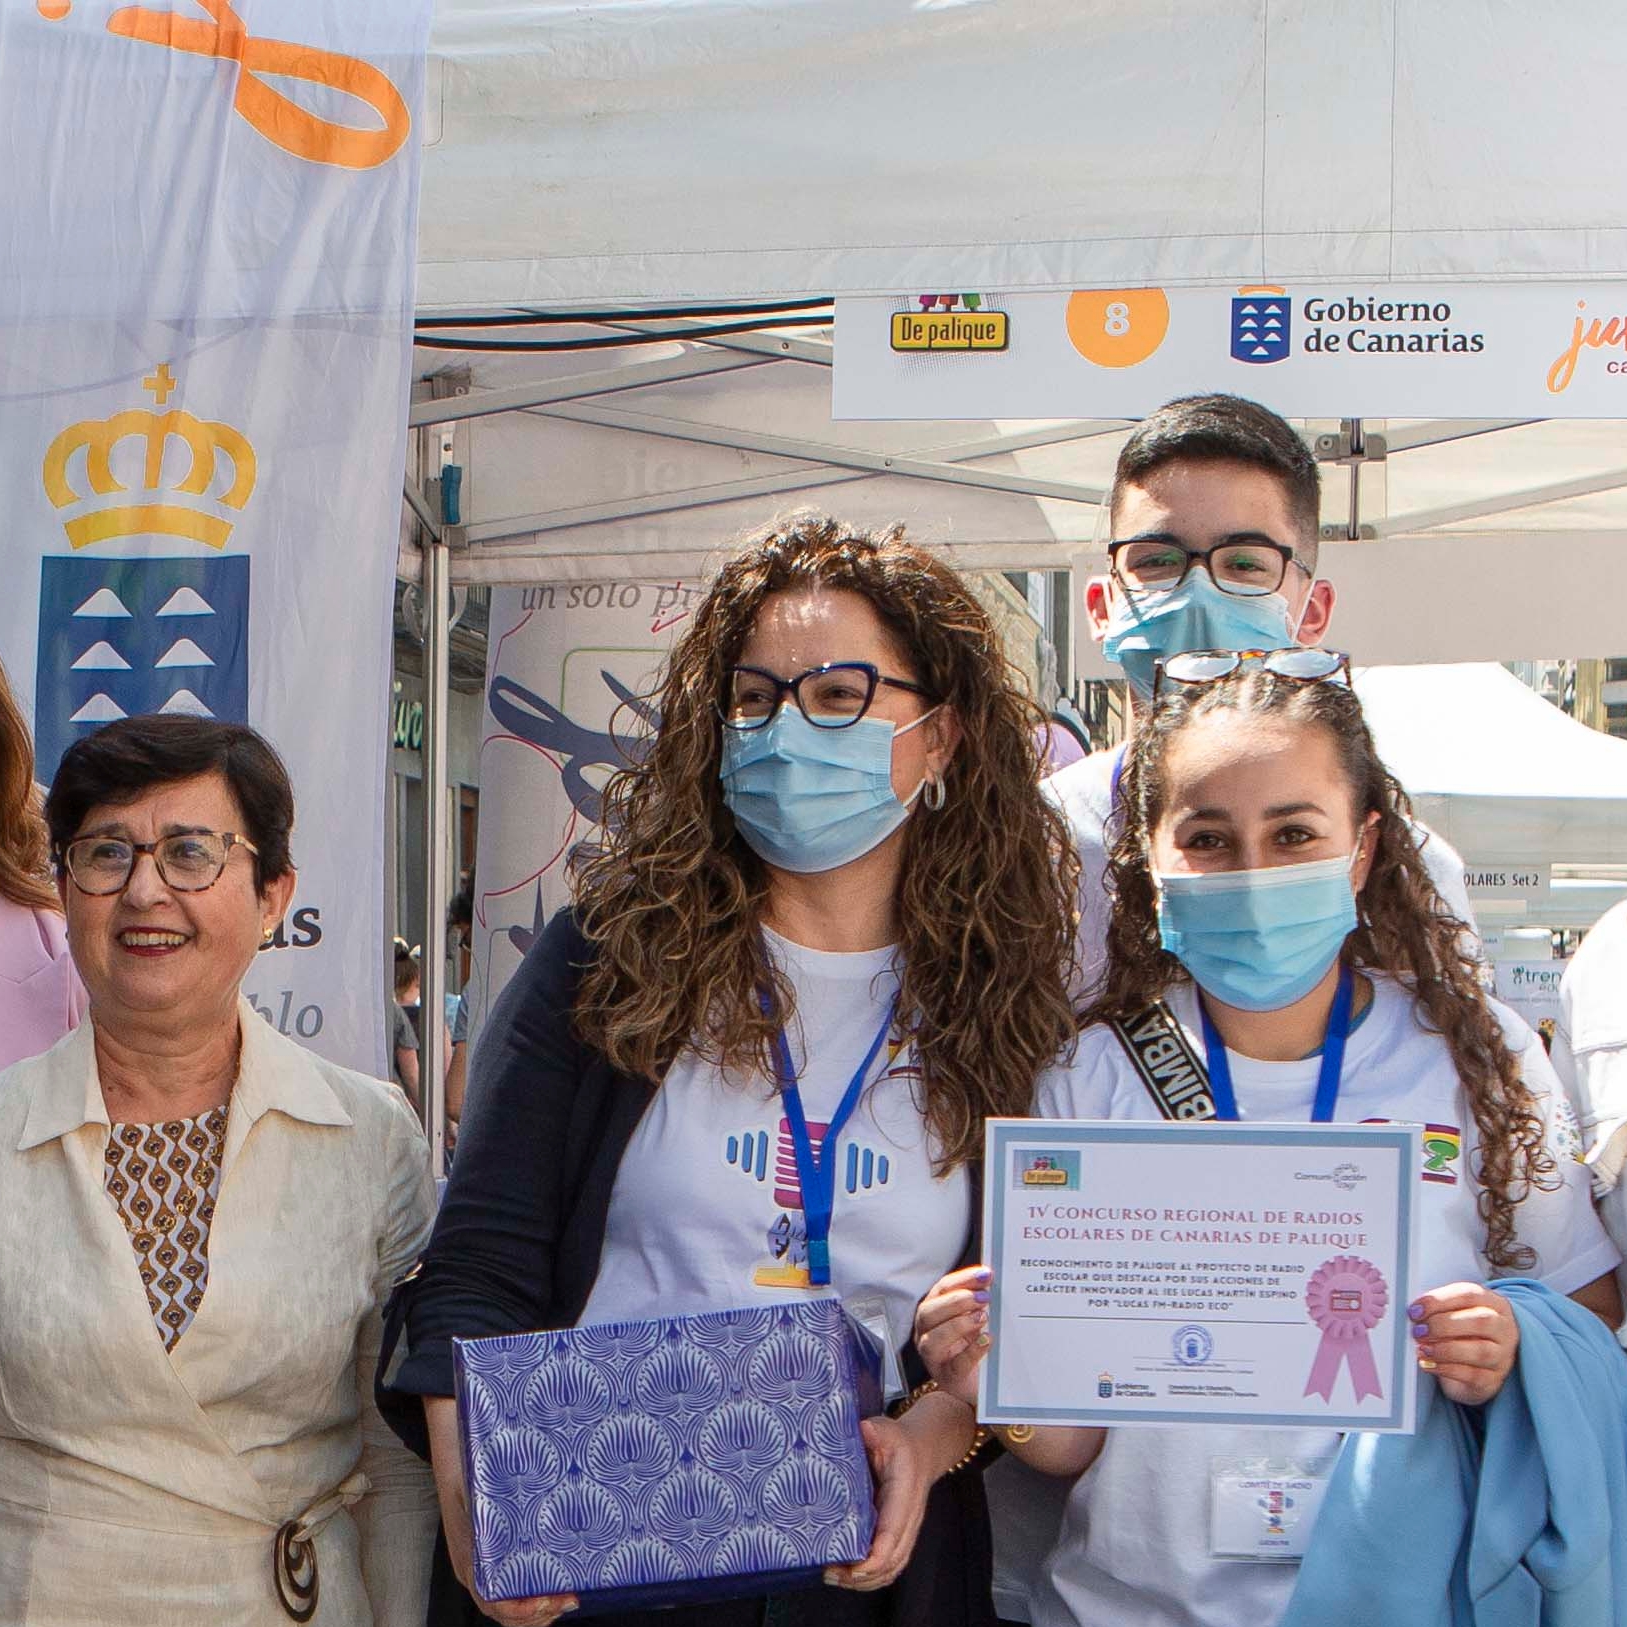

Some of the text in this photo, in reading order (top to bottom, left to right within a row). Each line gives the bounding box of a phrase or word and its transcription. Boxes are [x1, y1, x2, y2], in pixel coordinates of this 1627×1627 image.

[1103, 302, 1131, 337] 8
[1303, 297, 1452, 324] Gobierno
[901, 317, 996, 348] De palique
[1303, 328, 1485, 354] de Canarias
[523, 587, 557, 611] un
[566, 582, 641, 610] solo
[1463, 873, 1539, 887] OLARES Set 2
[1053, 1206, 1158, 1221] CONCURSO
[1164, 1208, 1257, 1224] REGIONAL
[1264, 1210, 1288, 1224] DE
[1293, 1211, 1364, 1225] RADIOS
[1023, 1226, 1368, 1250] ESCOLARES DE CANARIAS DE PALIQUE
[1020, 1258, 1305, 1273] RECONOCIMIENTO DE PALIQUE AL PROYECTO DE RADIO
[1043, 1272, 1281, 1286] ESCOLAR QUE DESTACA POR SUS ACCIONES DE
[1080, 1286, 1144, 1295] INNOVADOR
[1147, 1287, 1159, 1296] AL
[1163, 1288, 1178, 1296] IES
[1181, 1288, 1213, 1297] LUCAS
[1259, 1290, 1298, 1299] ESPINO
[1088, 1299, 1110, 1308] POR
